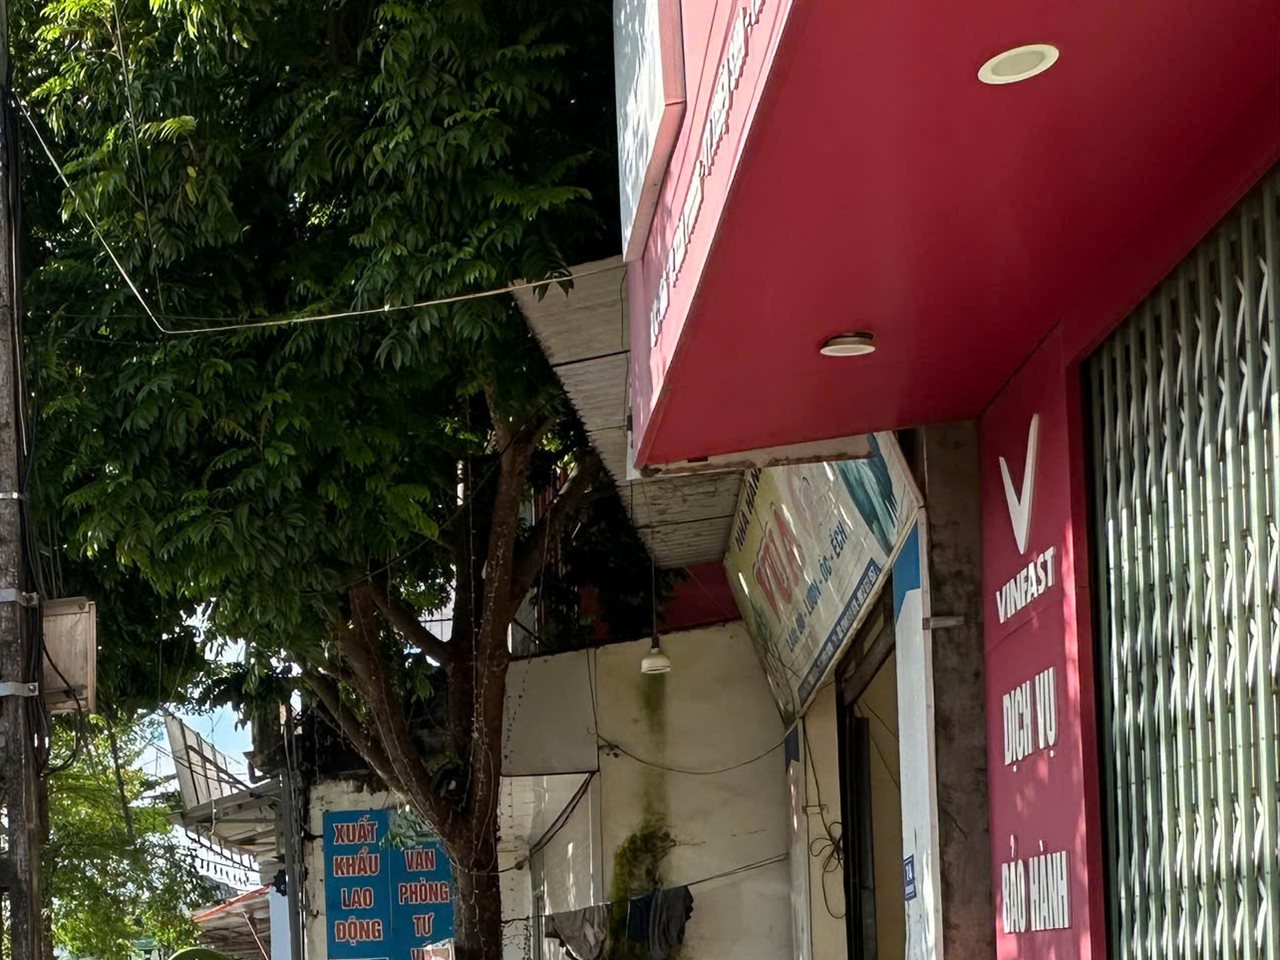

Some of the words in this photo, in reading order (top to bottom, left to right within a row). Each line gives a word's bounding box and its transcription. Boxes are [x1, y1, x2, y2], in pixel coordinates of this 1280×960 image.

[996, 546, 1055, 624] VINFAST
[1002, 680, 1033, 772] DỊCH
[1035, 666, 1056, 758] VỤ
[333, 814, 378, 845] XUẤT
[333, 846, 380, 877] KHẨU
[341, 886, 373, 909] LAO
[399, 877, 450, 904] PHÒNG
[1001, 834, 1028, 934] BẢO
[1028, 839, 1070, 932] HÀNH
[335, 915, 383, 946] ĐỘNG
[413, 912, 434, 937] TƯ
